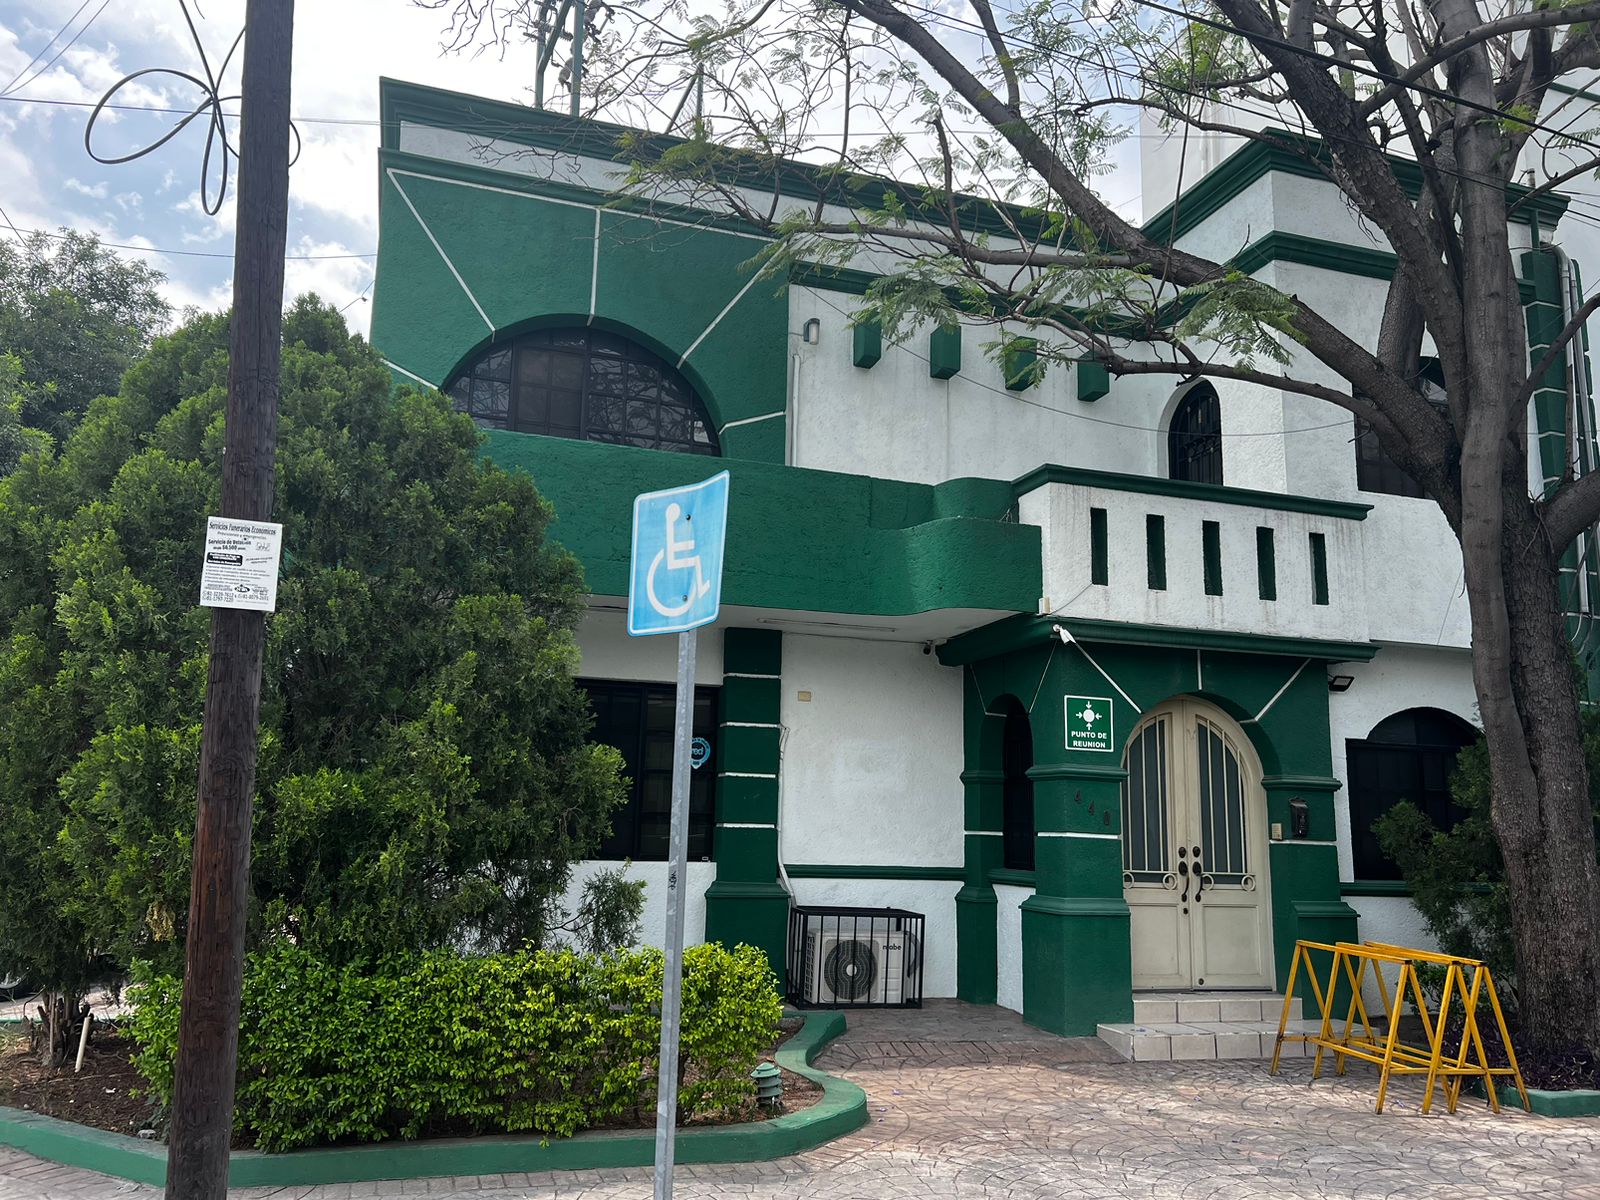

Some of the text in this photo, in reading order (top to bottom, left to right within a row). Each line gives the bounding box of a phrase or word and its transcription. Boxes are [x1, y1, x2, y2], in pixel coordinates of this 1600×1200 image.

[209, 522, 228, 531] Servicios
[229, 523, 250, 533] Funerarios
[1072, 740, 1106, 748] REUNION
